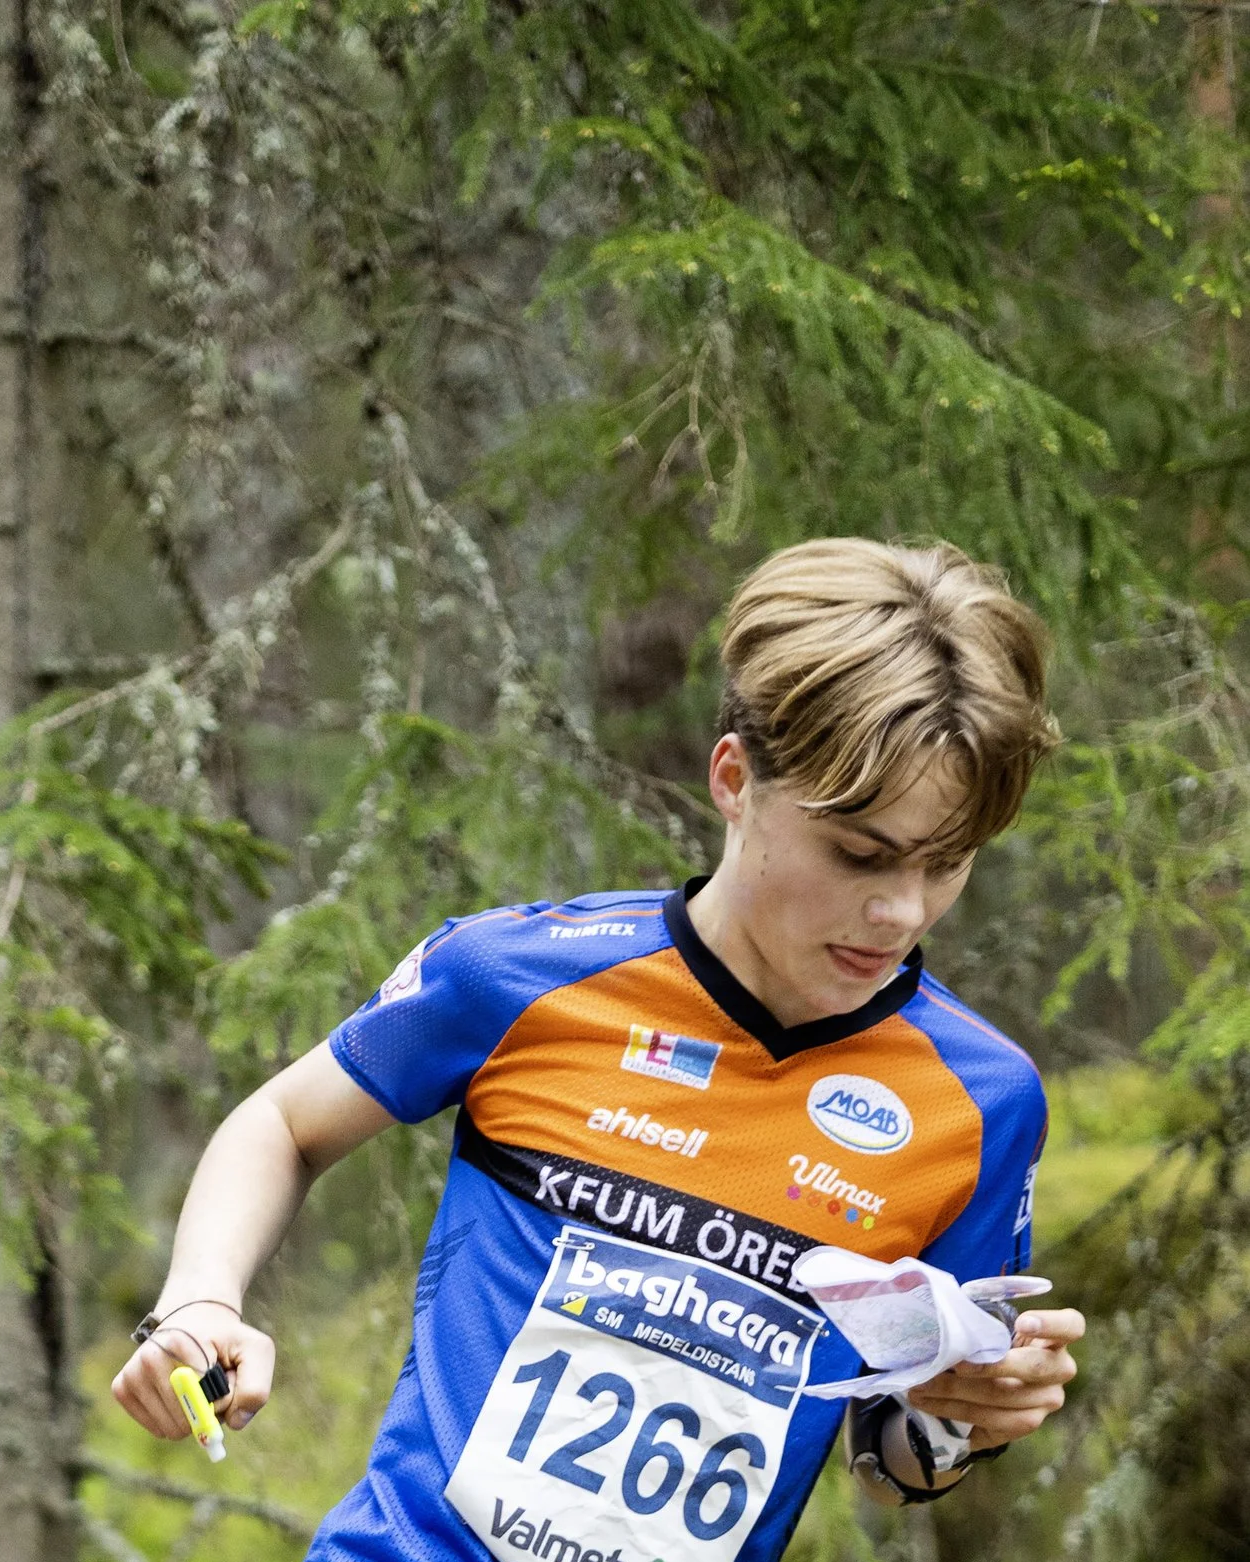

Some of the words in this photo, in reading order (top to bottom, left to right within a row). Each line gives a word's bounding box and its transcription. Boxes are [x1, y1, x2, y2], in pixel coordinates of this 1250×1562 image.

[550, 923, 637, 939] TRIMTEX
[587, 1107, 709, 1158] ahlsell
[815, 1090, 899, 1135] MOAB
[535, 1165, 685, 1244] KFUM
[788, 1154, 887, 1214] Ullmax
[566, 1249, 801, 1367] bagheera
[594, 1306, 625, 1330] SM
[507, 1349, 766, 1541] 1266
